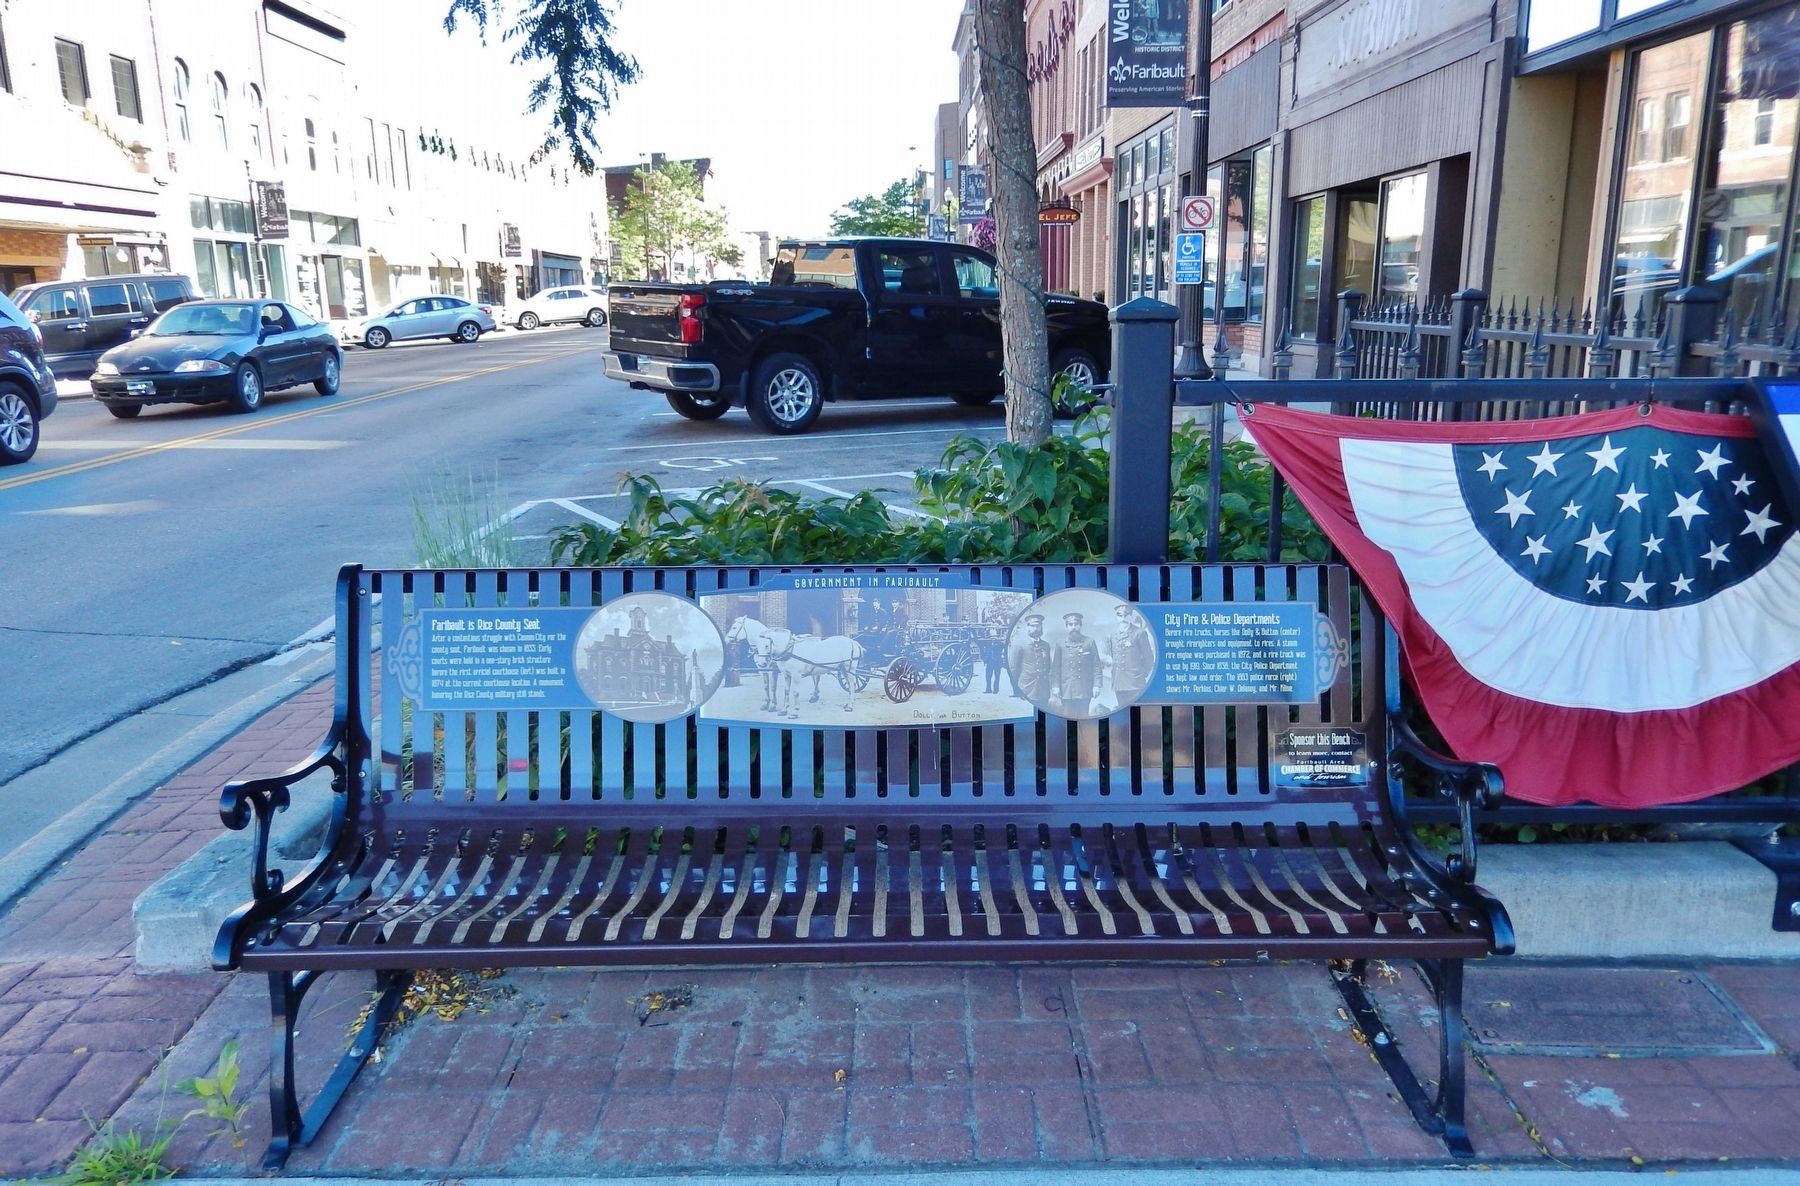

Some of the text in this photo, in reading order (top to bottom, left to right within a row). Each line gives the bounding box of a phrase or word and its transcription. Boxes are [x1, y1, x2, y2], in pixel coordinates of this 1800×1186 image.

[1113, 0, 1129, 42] Wel
[1132, 63, 1185, 79] Faribault
[795, 577, 939, 588] GOVERNMENT IN FARIBAULT
[1165, 613, 1280, 627] City Fire & Police Departments
[432, 619, 540, 632] Faribault is Rice County Seat
[482, 634, 502, 643] struggle
[539, 645, 552, 654] Early
[1242, 662, 1252, 671] City
[1176, 673, 1187, 682] kept
[1250, 673, 1263, 682] police
[1280, 673, 1297, 682] (right)
[476, 691, 493, 700] County
[495, 691, 515, 700] military
[913, 710, 933, 718] DOLL
[1290, 733, 1350, 747] Sponsor this Bench
[1281, 765, 1314, 774] CHAMBER
[1324, 765, 1360, 774] COMMERCE
